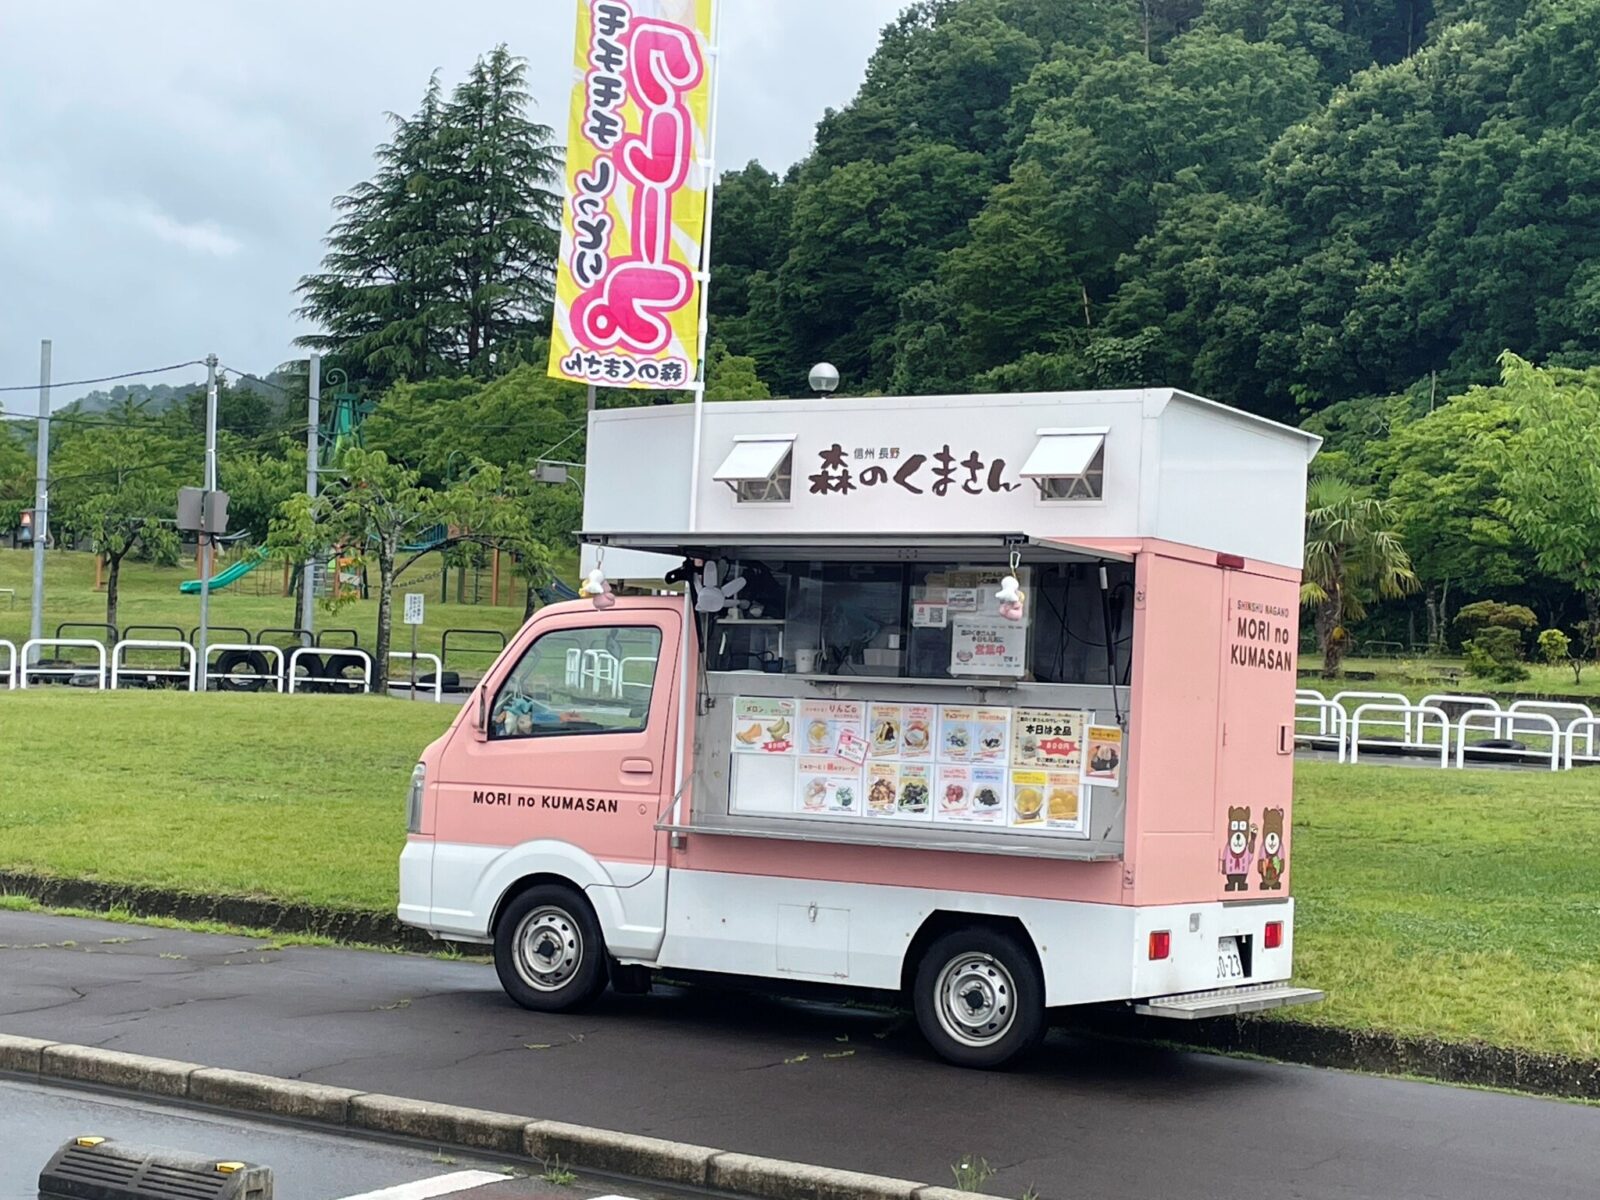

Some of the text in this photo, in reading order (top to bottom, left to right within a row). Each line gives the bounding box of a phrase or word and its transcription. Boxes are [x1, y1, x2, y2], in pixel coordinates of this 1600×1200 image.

[854, 447, 900, 460] 信州 長野
[808, 443, 1021, 496] 森のくまさん
[1237, 600, 1289, 618] SHINSHU NAGANO
[1237, 617, 1289, 645] MORI no
[1231, 644, 1292, 672] KUMASAN
[473, 790, 618, 813] MORI no KUMASAN
